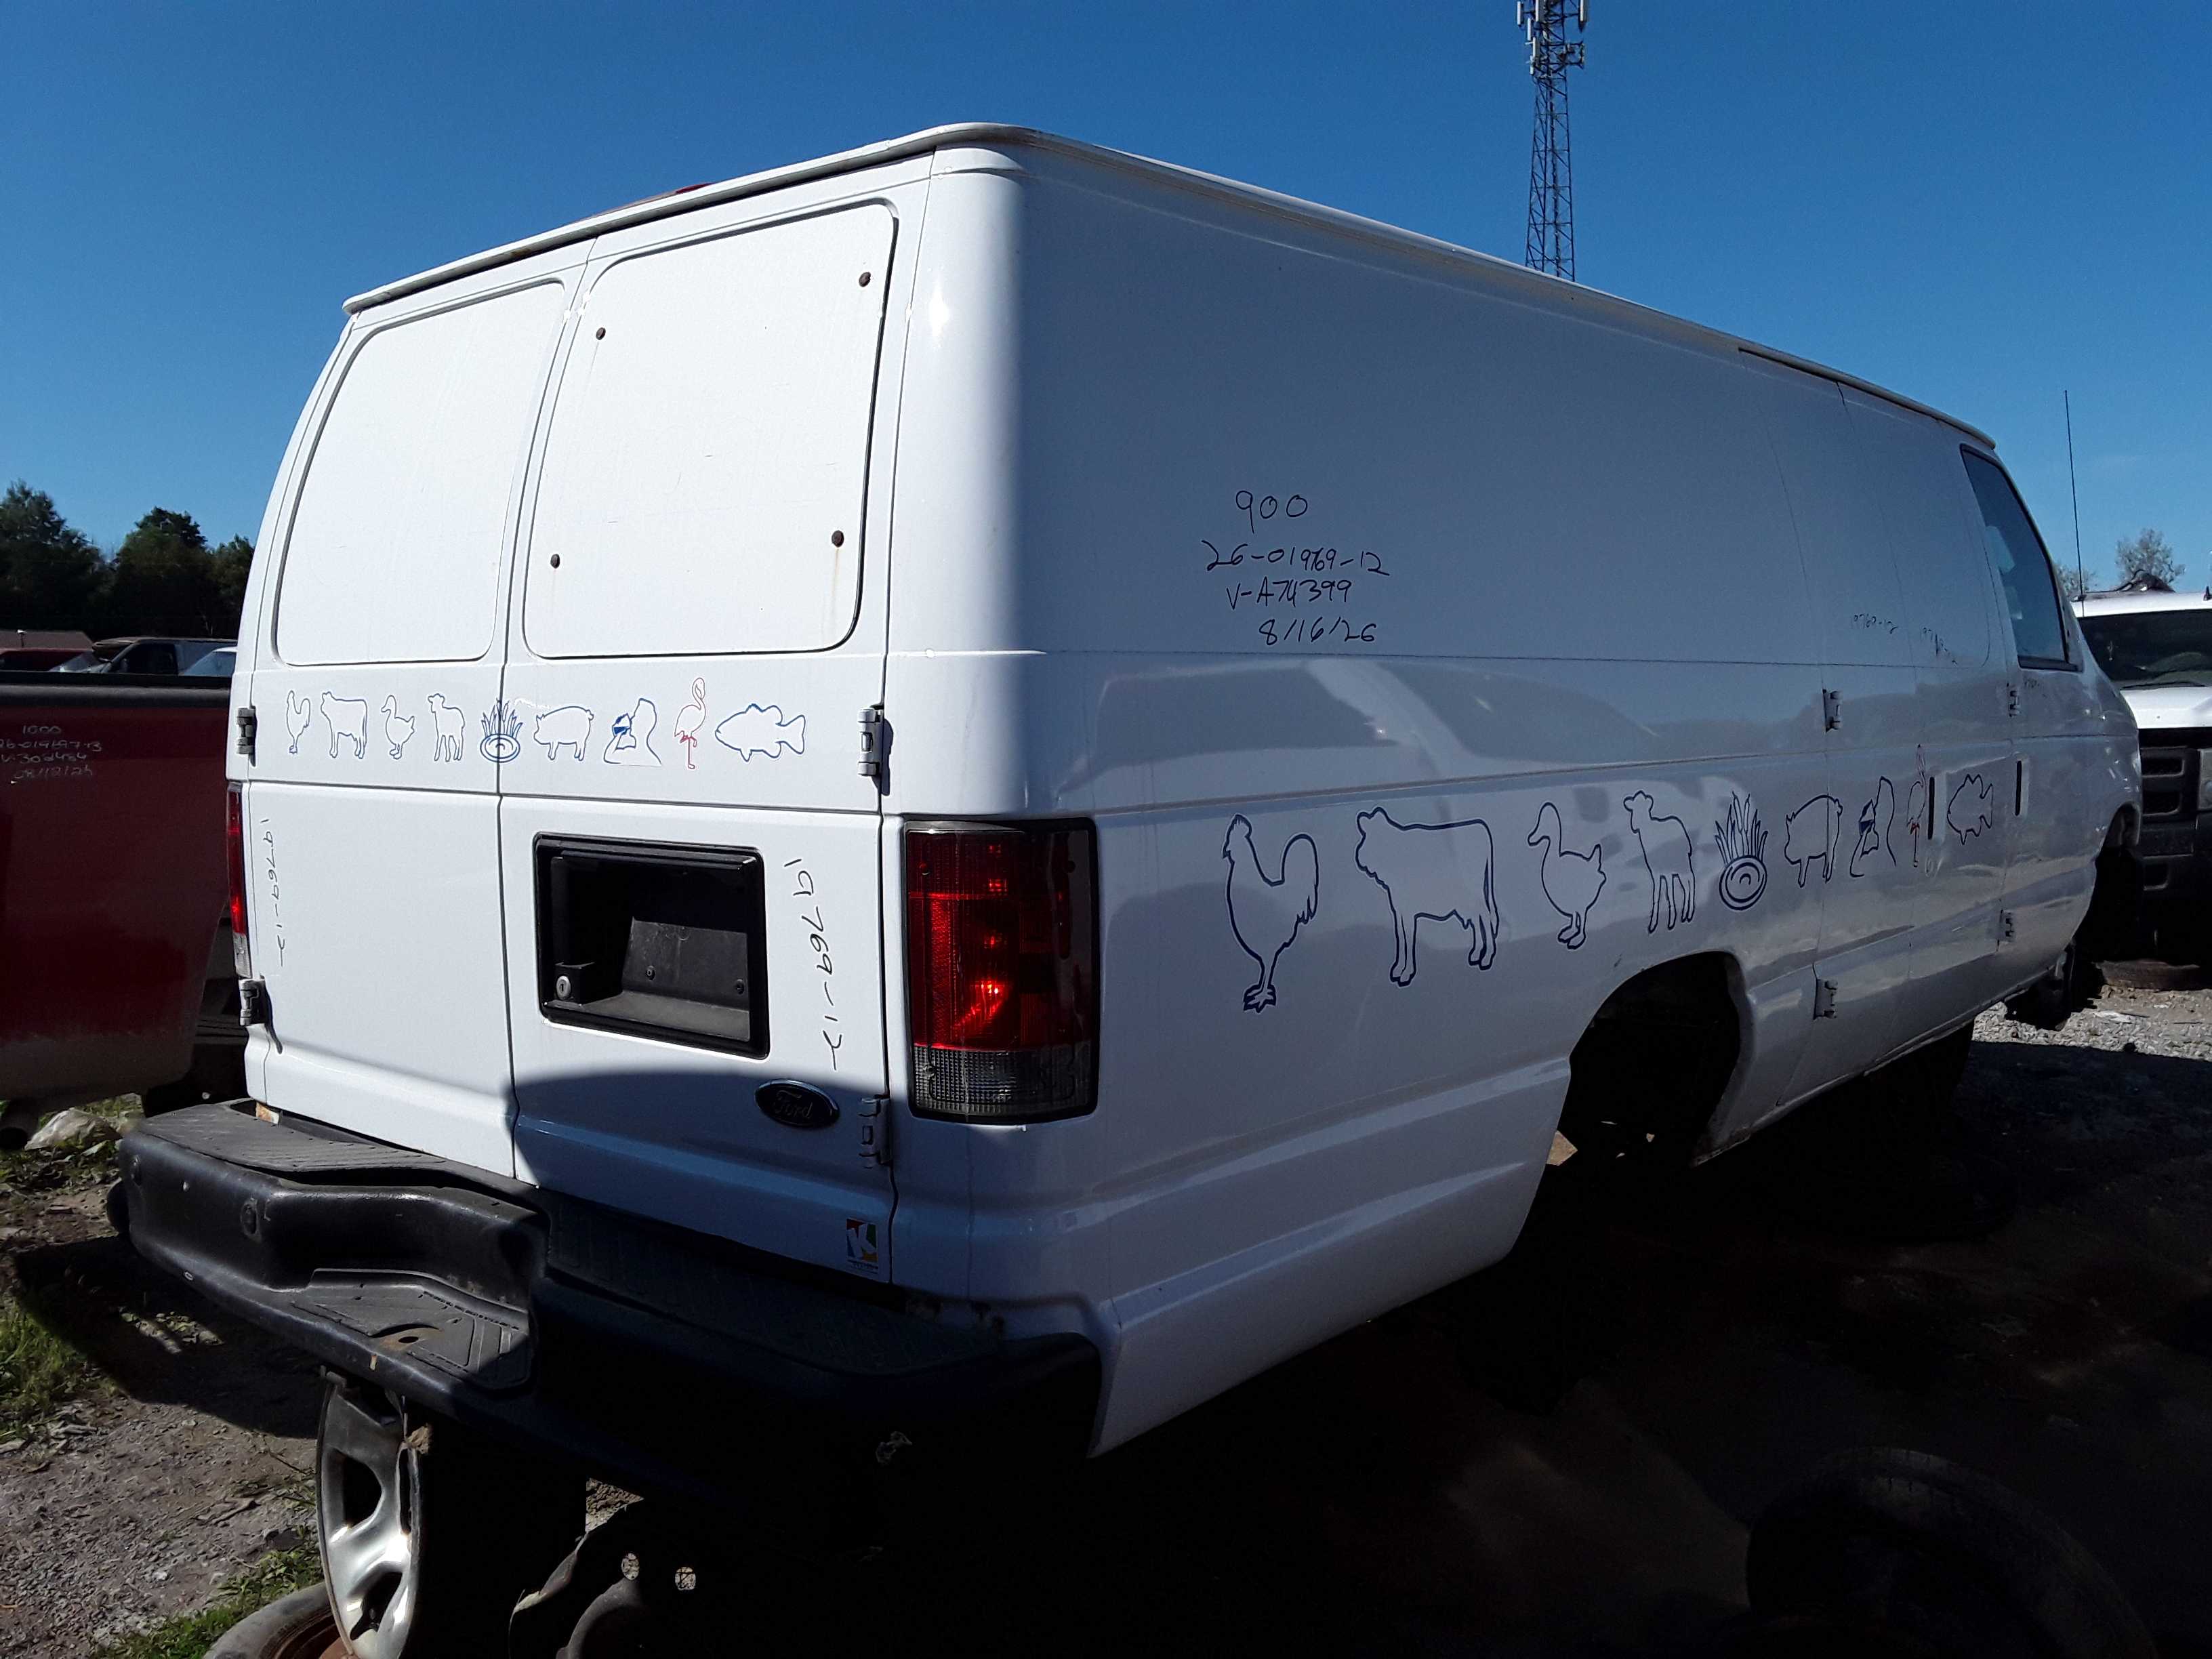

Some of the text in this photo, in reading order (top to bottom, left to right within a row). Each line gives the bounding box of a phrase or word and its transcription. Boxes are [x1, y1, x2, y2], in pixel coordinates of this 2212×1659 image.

[1235, 490, 1308, 533] 900
[1226, 576, 1353, 611] V-A74399
[1258, 616, 1377, 646] 8/16/26
[22, 724, 62, 735] 1000
[773, 1089, 813, 1119] Ford
